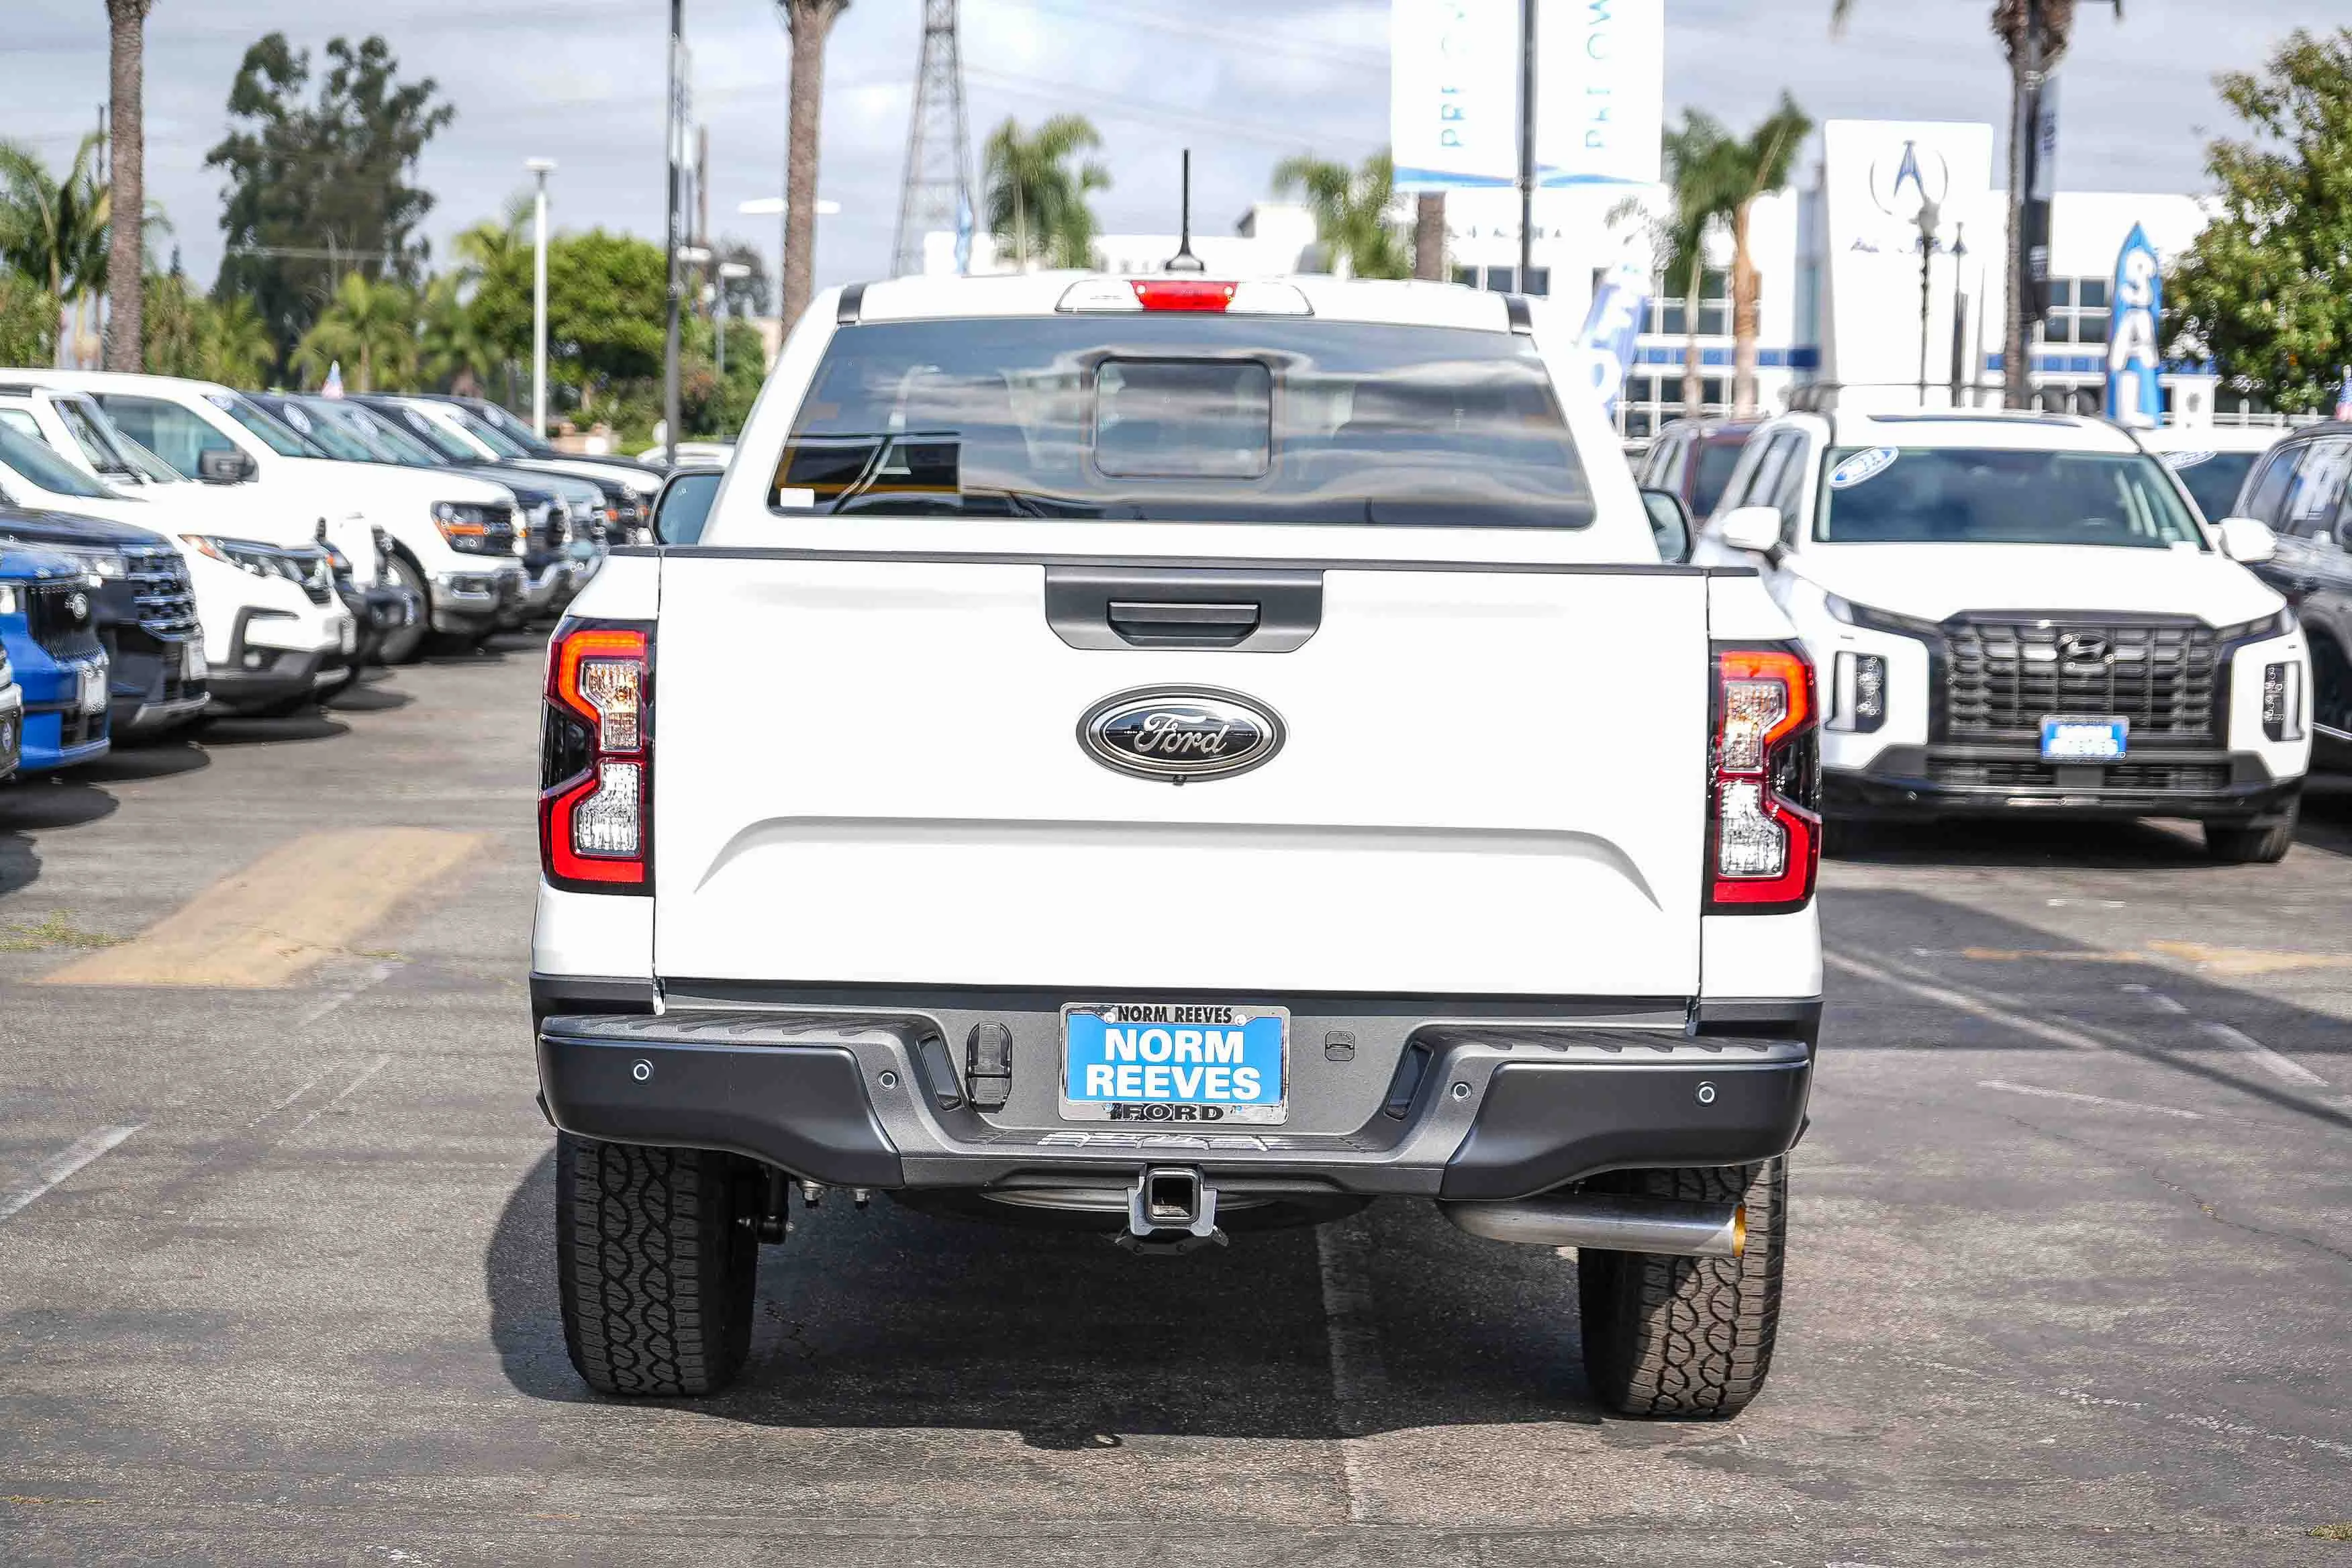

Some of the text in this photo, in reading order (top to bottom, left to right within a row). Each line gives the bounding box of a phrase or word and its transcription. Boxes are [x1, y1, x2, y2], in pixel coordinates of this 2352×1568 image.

[1134, 712, 1230, 753] Ford
[1118, 1006, 1232, 1024] NORM REEVES
[1105, 1028, 1244, 1063] NORM
[1086, 1064, 1261, 1101] REEVES
[1122, 1104, 1224, 1121] FORD
